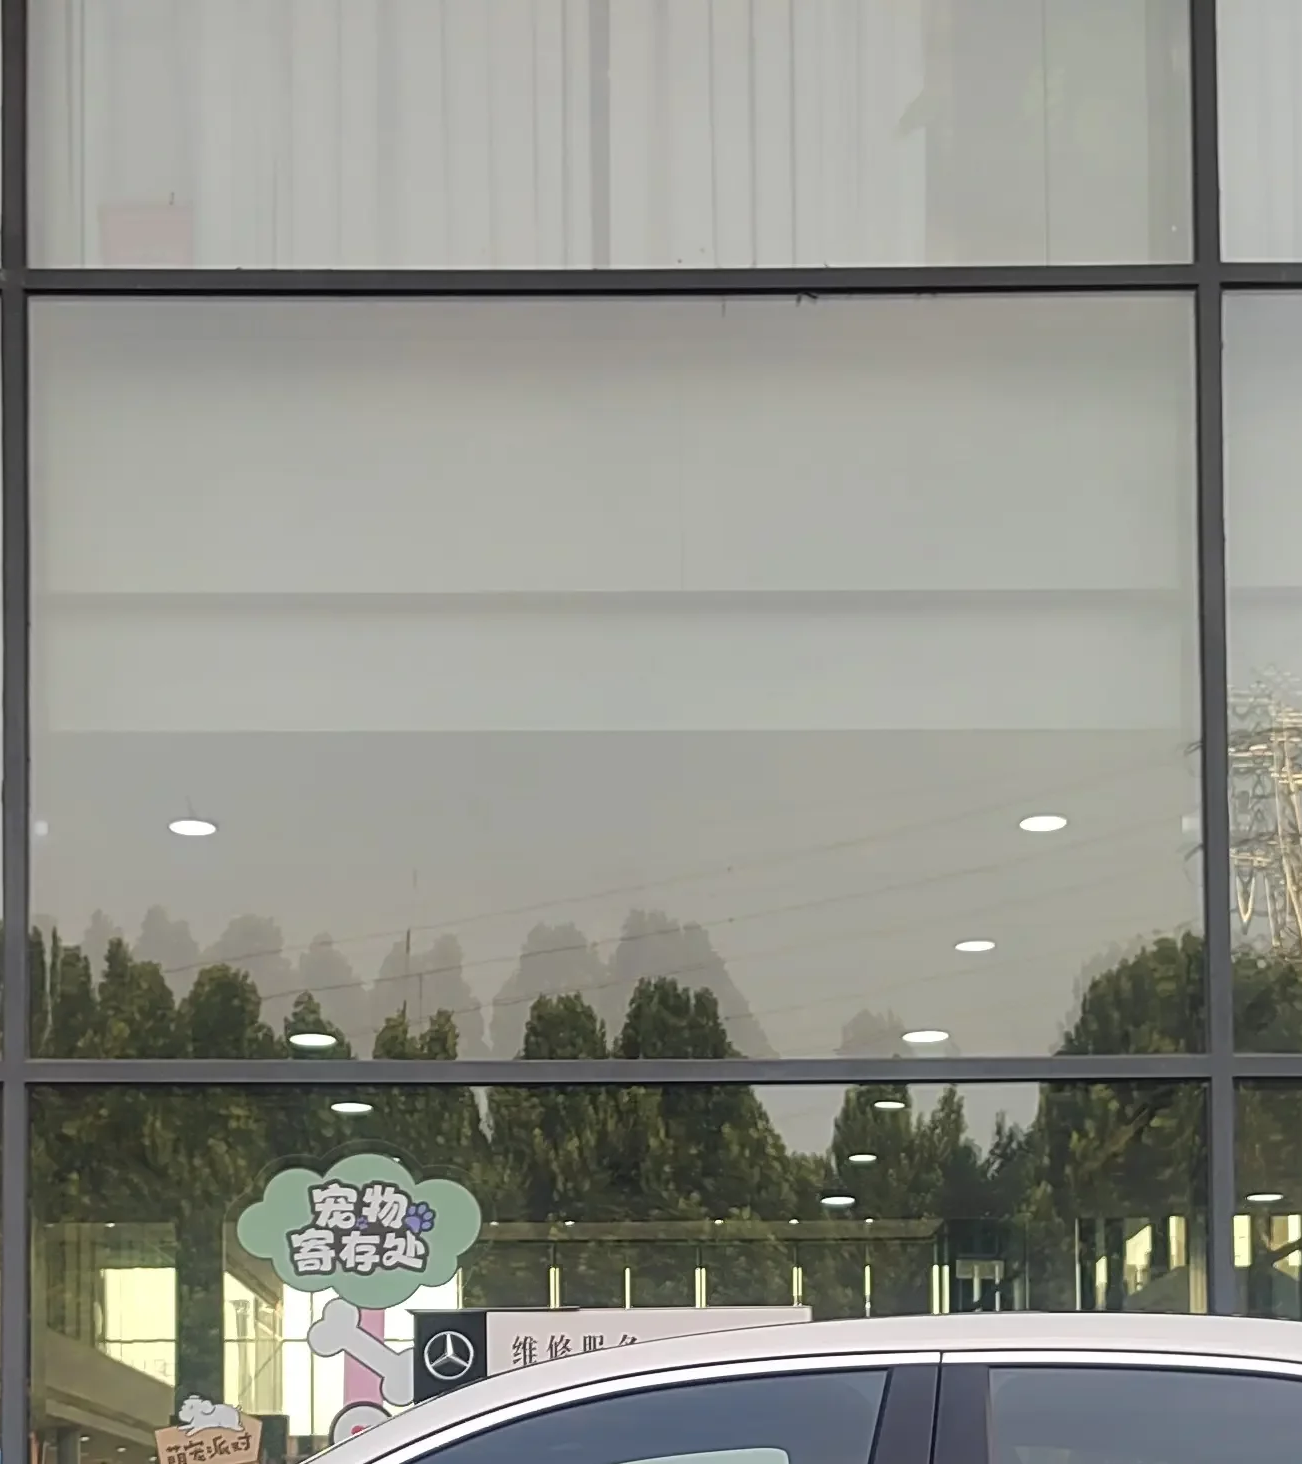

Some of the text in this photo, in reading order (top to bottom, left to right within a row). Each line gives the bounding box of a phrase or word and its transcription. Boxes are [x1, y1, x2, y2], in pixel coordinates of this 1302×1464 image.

[311, 1182, 409, 1229] 宠物
[290, 1228, 426, 1272] 寄存处
